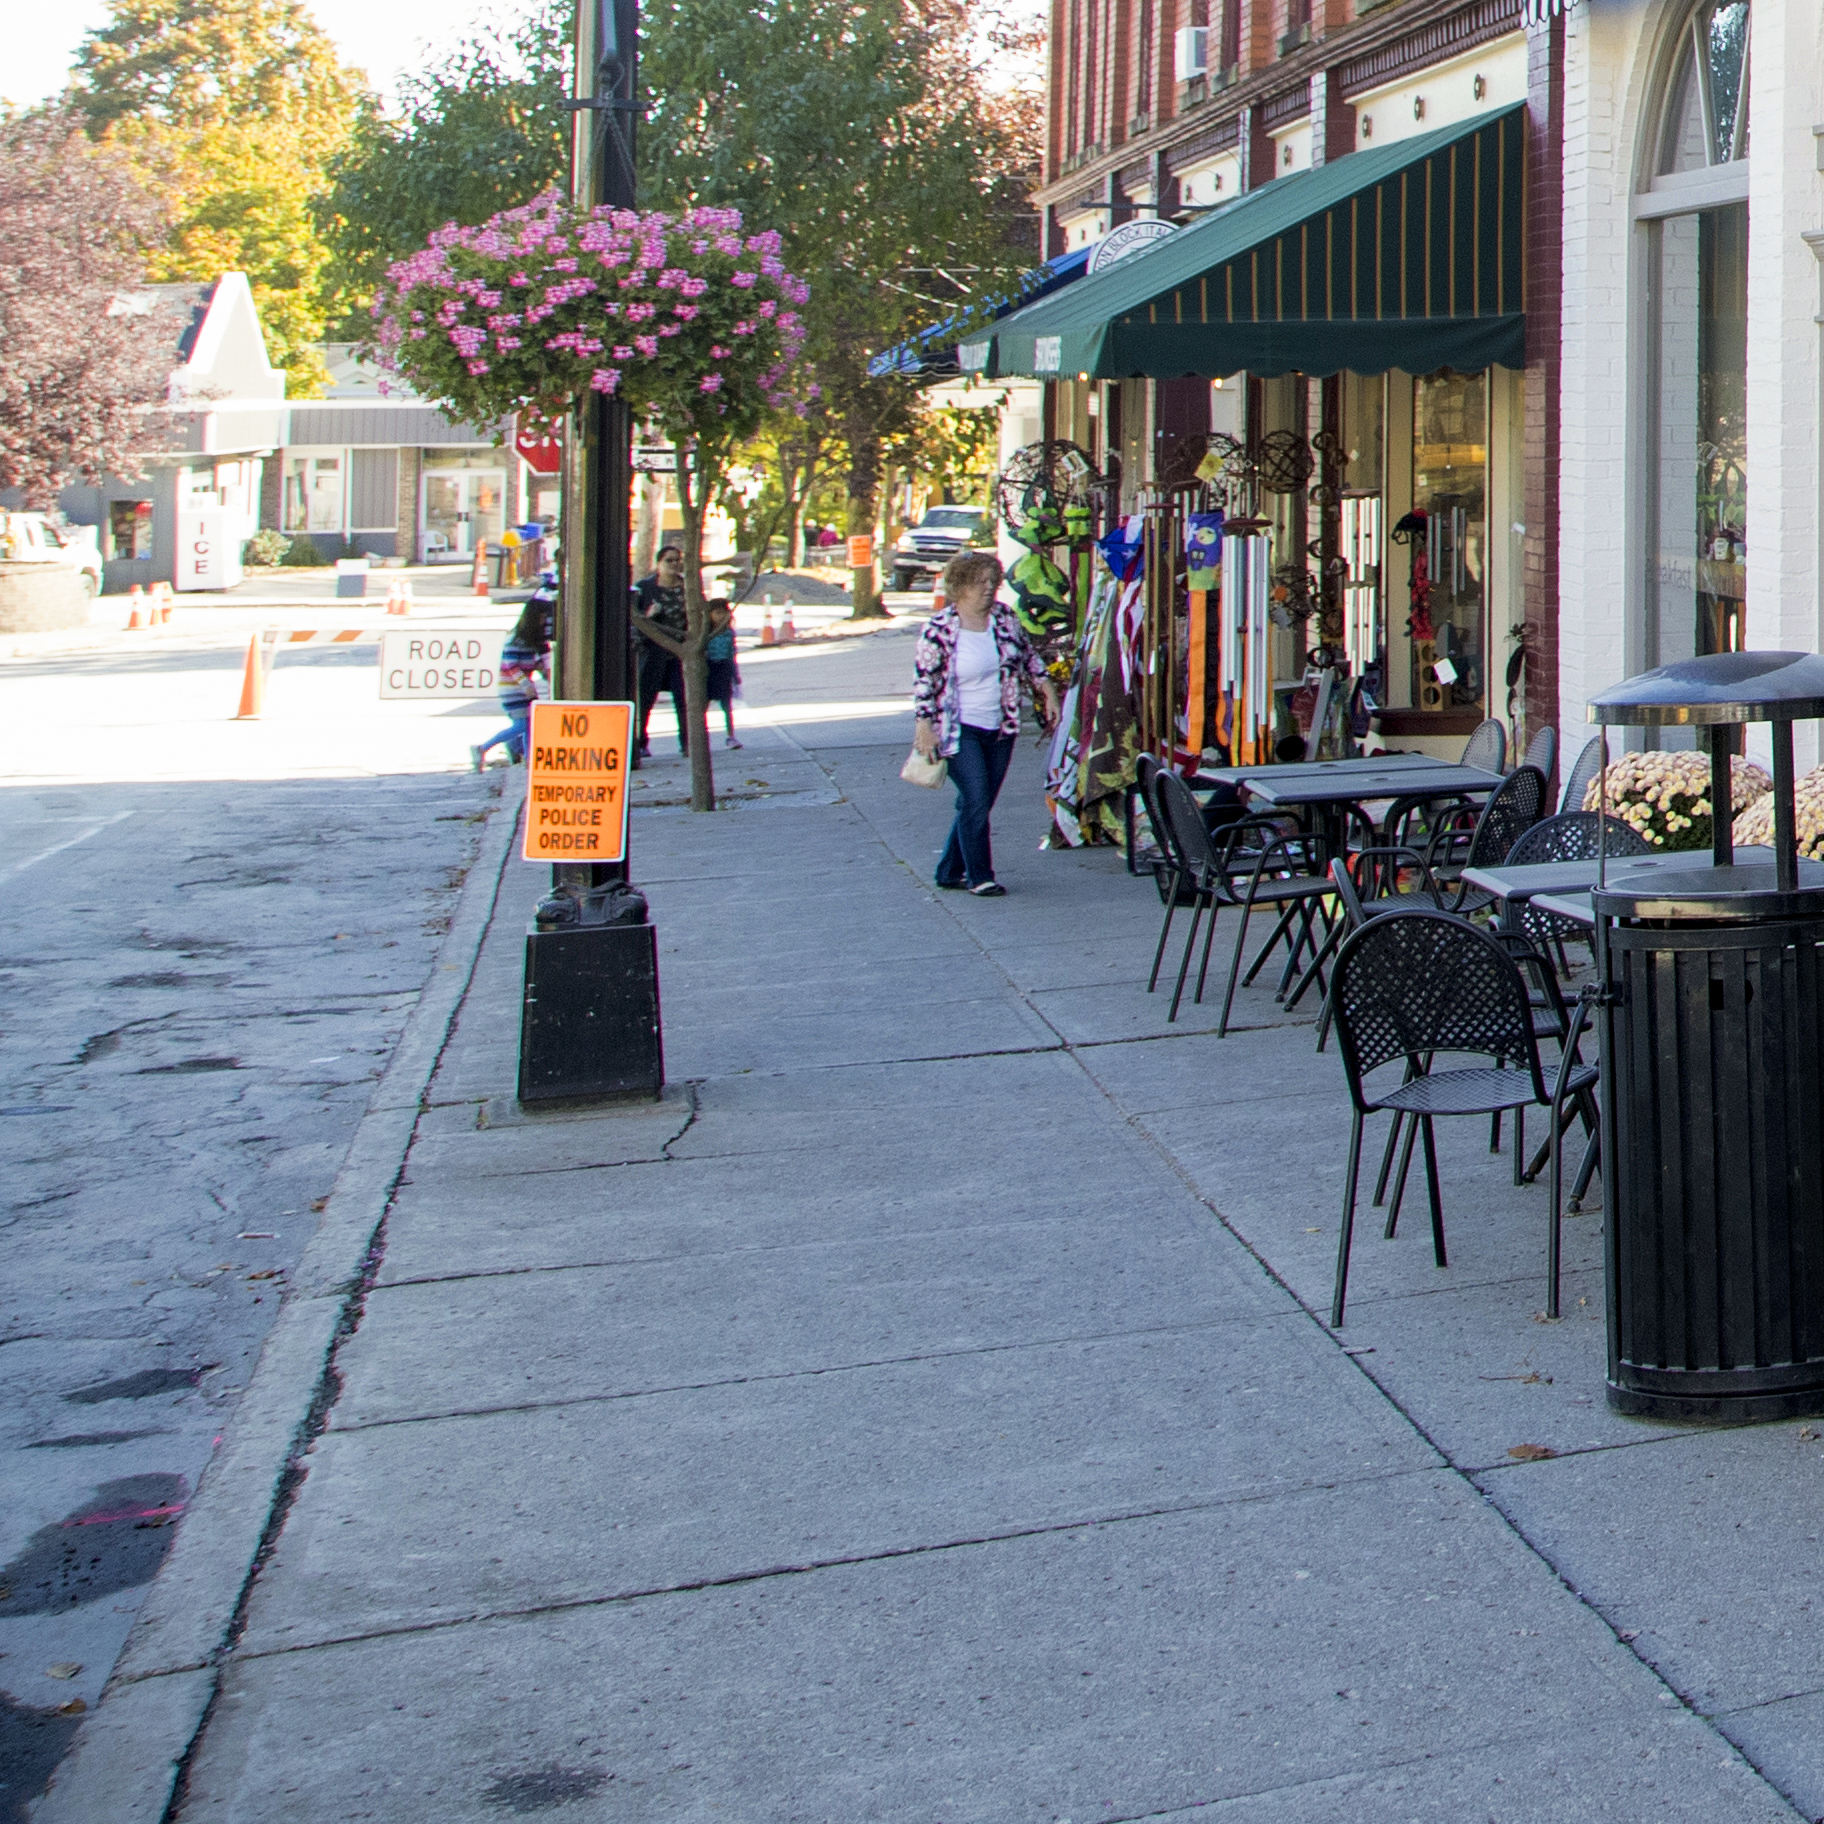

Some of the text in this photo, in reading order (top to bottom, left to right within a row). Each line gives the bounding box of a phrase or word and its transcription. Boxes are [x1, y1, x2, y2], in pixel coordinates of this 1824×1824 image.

[409, 640, 482, 660] ROAD
[389, 669, 494, 689] CLOSED
[561, 713, 589, 738] NO
[534, 747, 618, 771] PARKING
[533, 785, 617, 803] TEMPORARY
[540, 808, 602, 826] POLICE
[539, 832, 600, 850] ORDER
